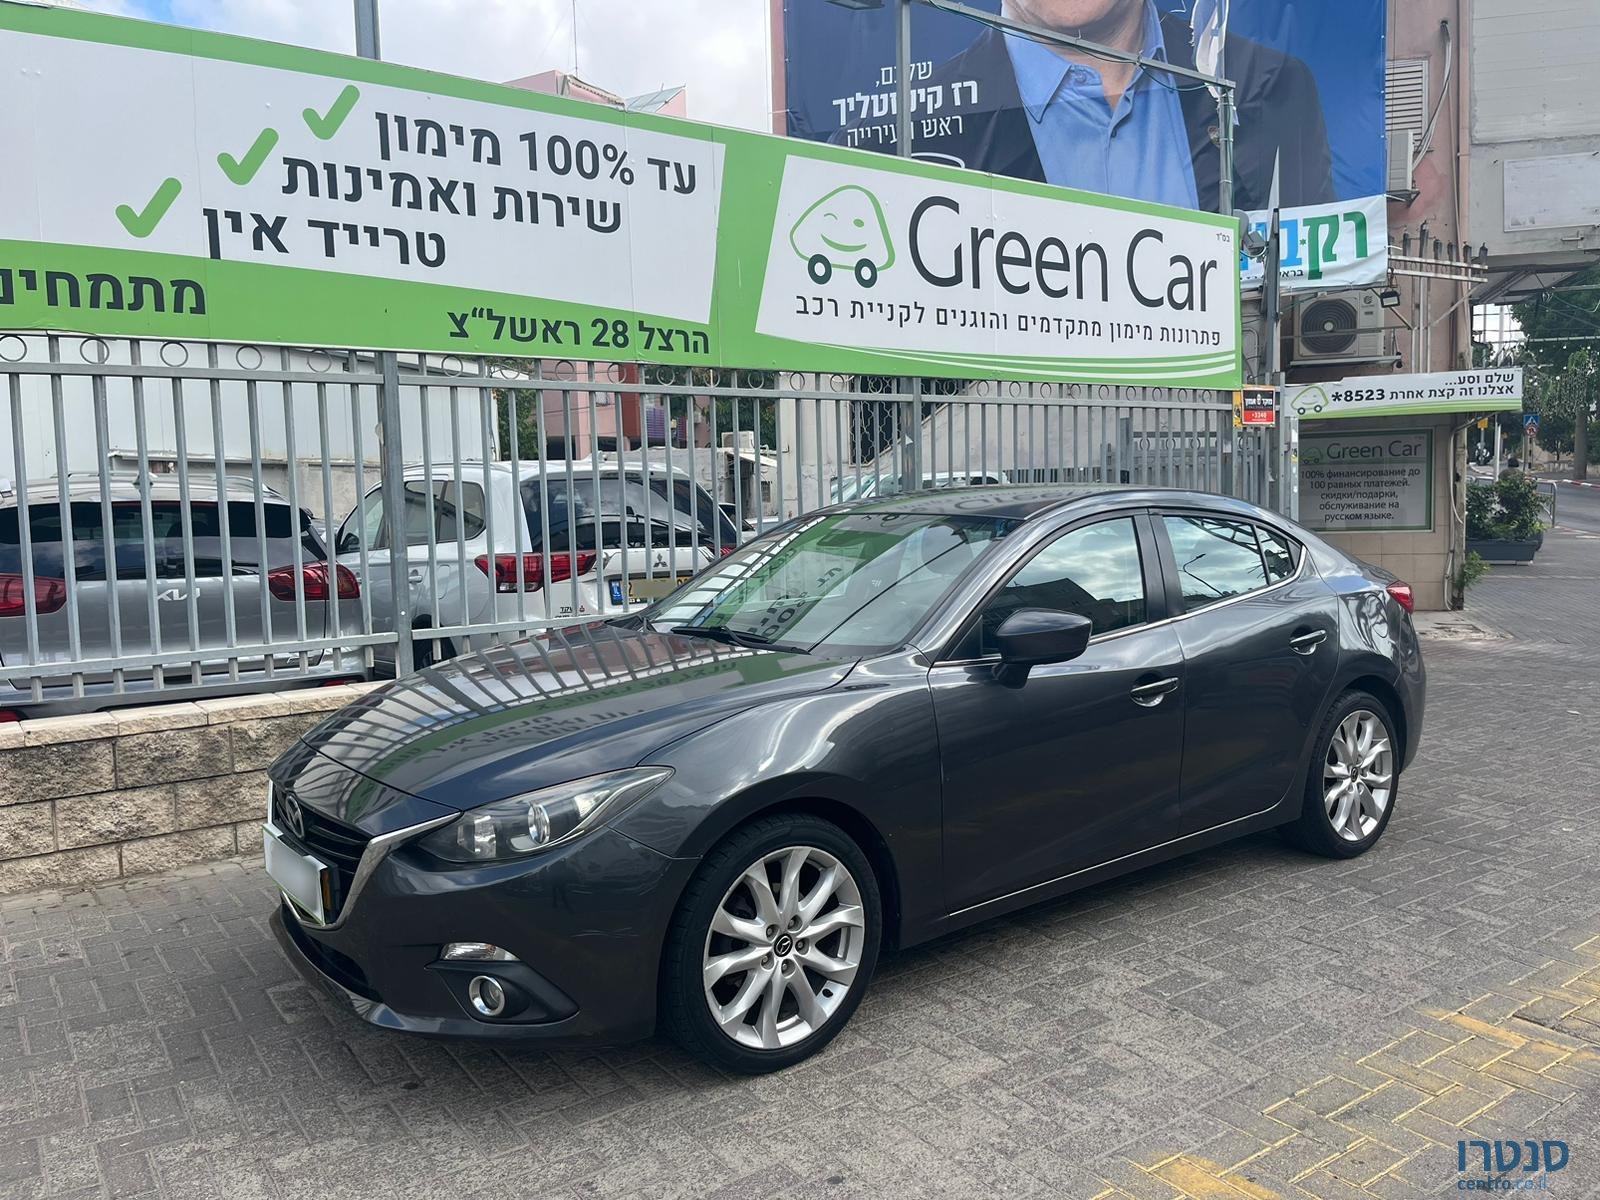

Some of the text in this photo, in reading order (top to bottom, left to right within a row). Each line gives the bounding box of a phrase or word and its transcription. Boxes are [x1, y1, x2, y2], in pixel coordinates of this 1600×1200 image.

[951, 80, 978, 105] רז
[921, 115, 963, 139] ראש
[375, 111, 696, 195] עד 100% מימון
[281, 156, 621, 233] שירות ואמינות
[203, 207, 446, 268] טרייד אין
[908, 195, 1109, 303] Green
[1126, 228, 1217, 312] Car
[796, 295, 1221, 347] פתרונות מימון מתקדמים והוגנים לקניית רכב
[592, 318, 630, 349] 28
[638, 320, 710, 355] הרצל
[1484, 372, 1515, 384] שלם
[1389, 383, 1514, 401] אצלנו זה קצת אחרת
[1326, 440, 1422, 460] Green Car
[1300, 468, 1421, 479] 100% финансирование до
[1310, 480, 1326, 490] 100
[1327, 479, 1362, 490] равных
[1319, 501, 1400, 513] обслуживание на
[1324, 512, 1363, 523] русском
